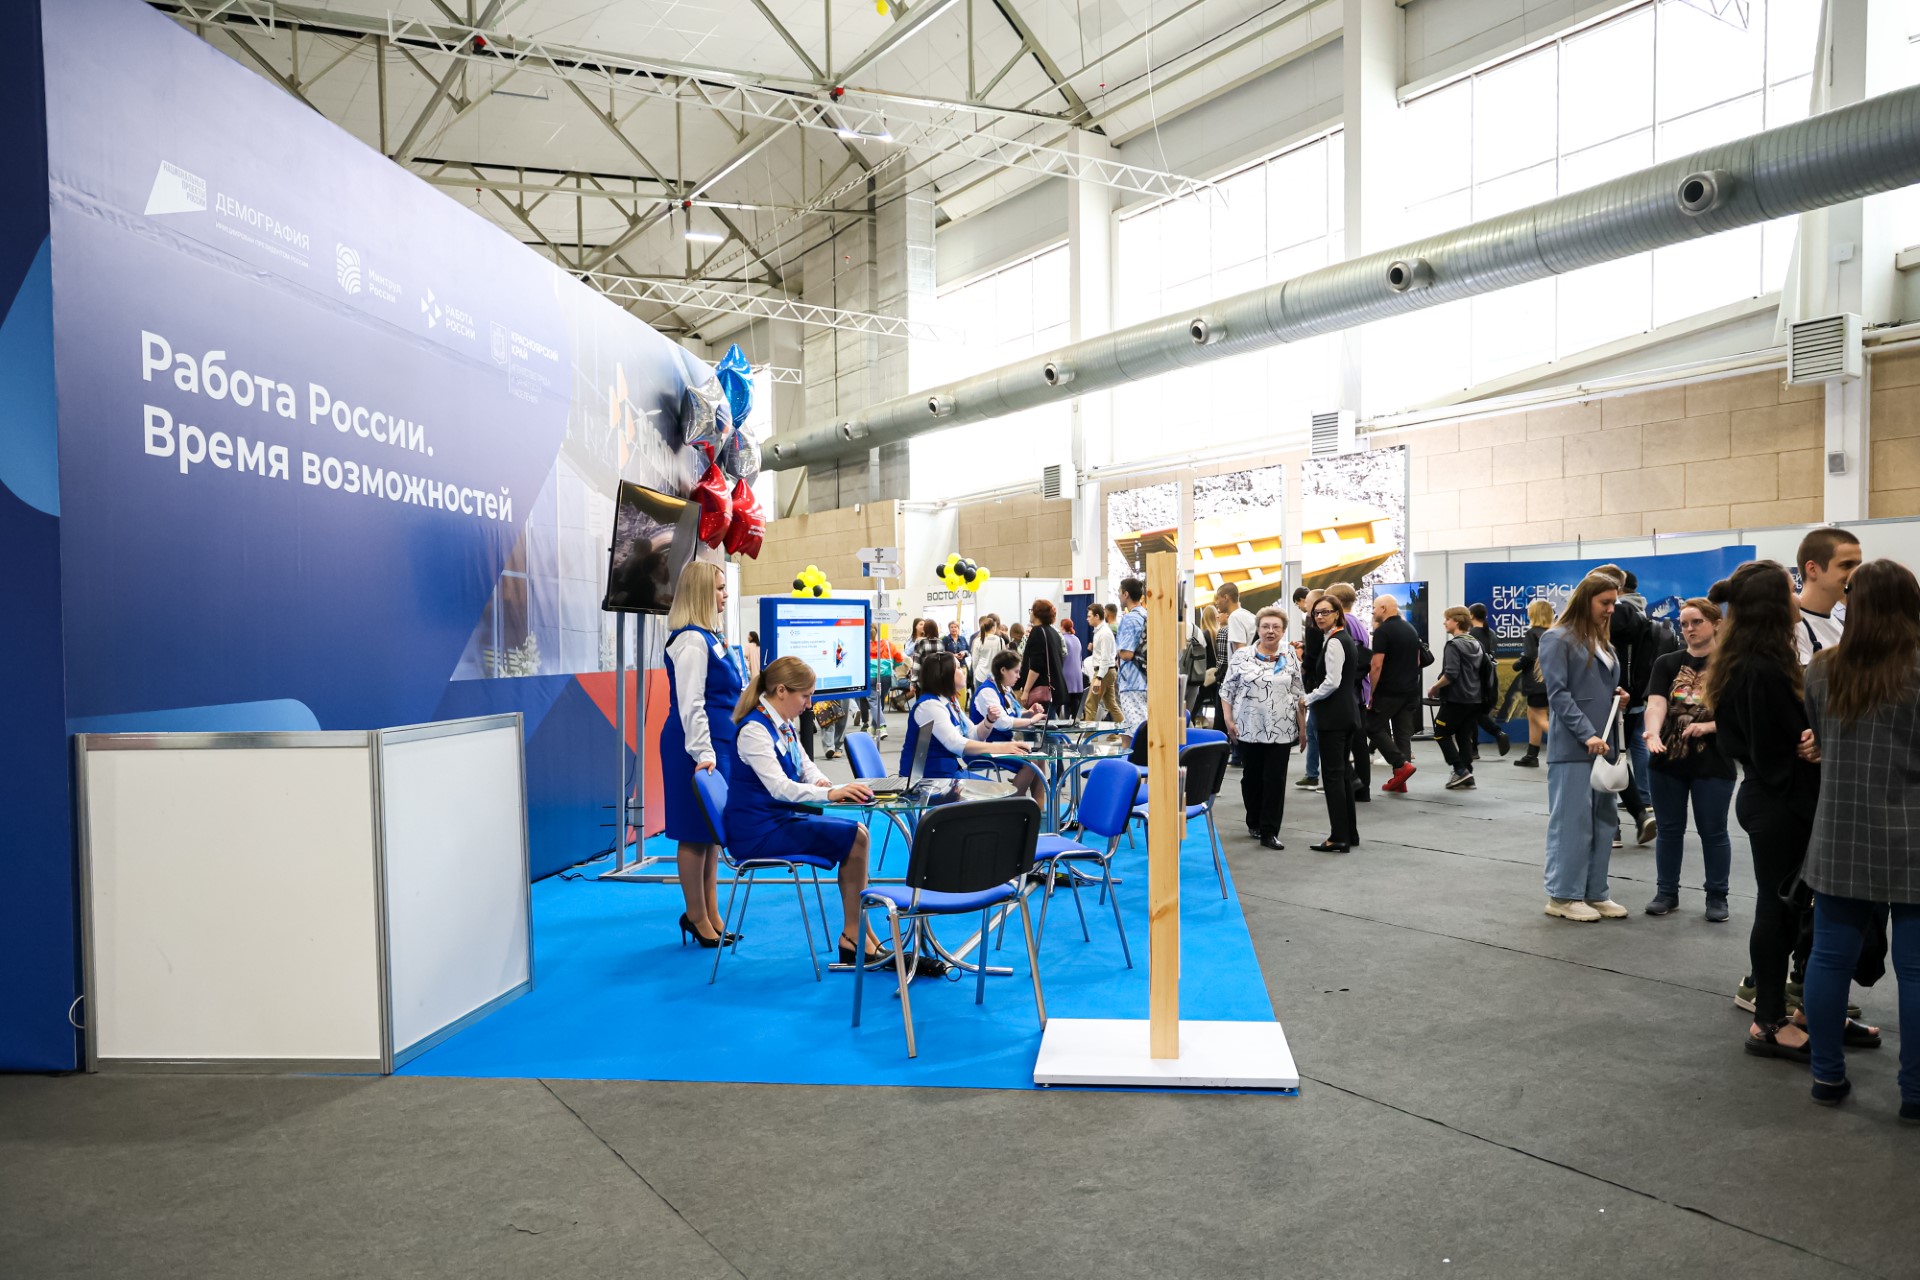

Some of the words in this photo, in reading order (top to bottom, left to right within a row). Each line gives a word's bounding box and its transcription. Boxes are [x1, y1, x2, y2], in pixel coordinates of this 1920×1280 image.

[163, 162, 206, 190] НАЦИОНАЛЬНЫЕ
[181, 179, 206, 200] ПРОЕКТЫ
[186, 191, 206, 209] РОССИИ
[215, 192, 309, 251] ДЕМОГРАФИЯ
[368, 268, 402, 295] Минтруд
[369, 282, 396, 303] России
[445, 304, 474, 326] РАБОТА
[445, 317, 476, 341] РОССИИ
[511, 330, 559, 362] КРАСНОЯРСКИЙ
[511, 343, 529, 361] КРАЙ
[142, 330, 296, 420] Работа
[309, 382, 434, 457] России.
[143, 404, 290, 480] Время
[302, 451, 513, 522] возможностей
[926, 590, 960, 602] ВОСТОК
